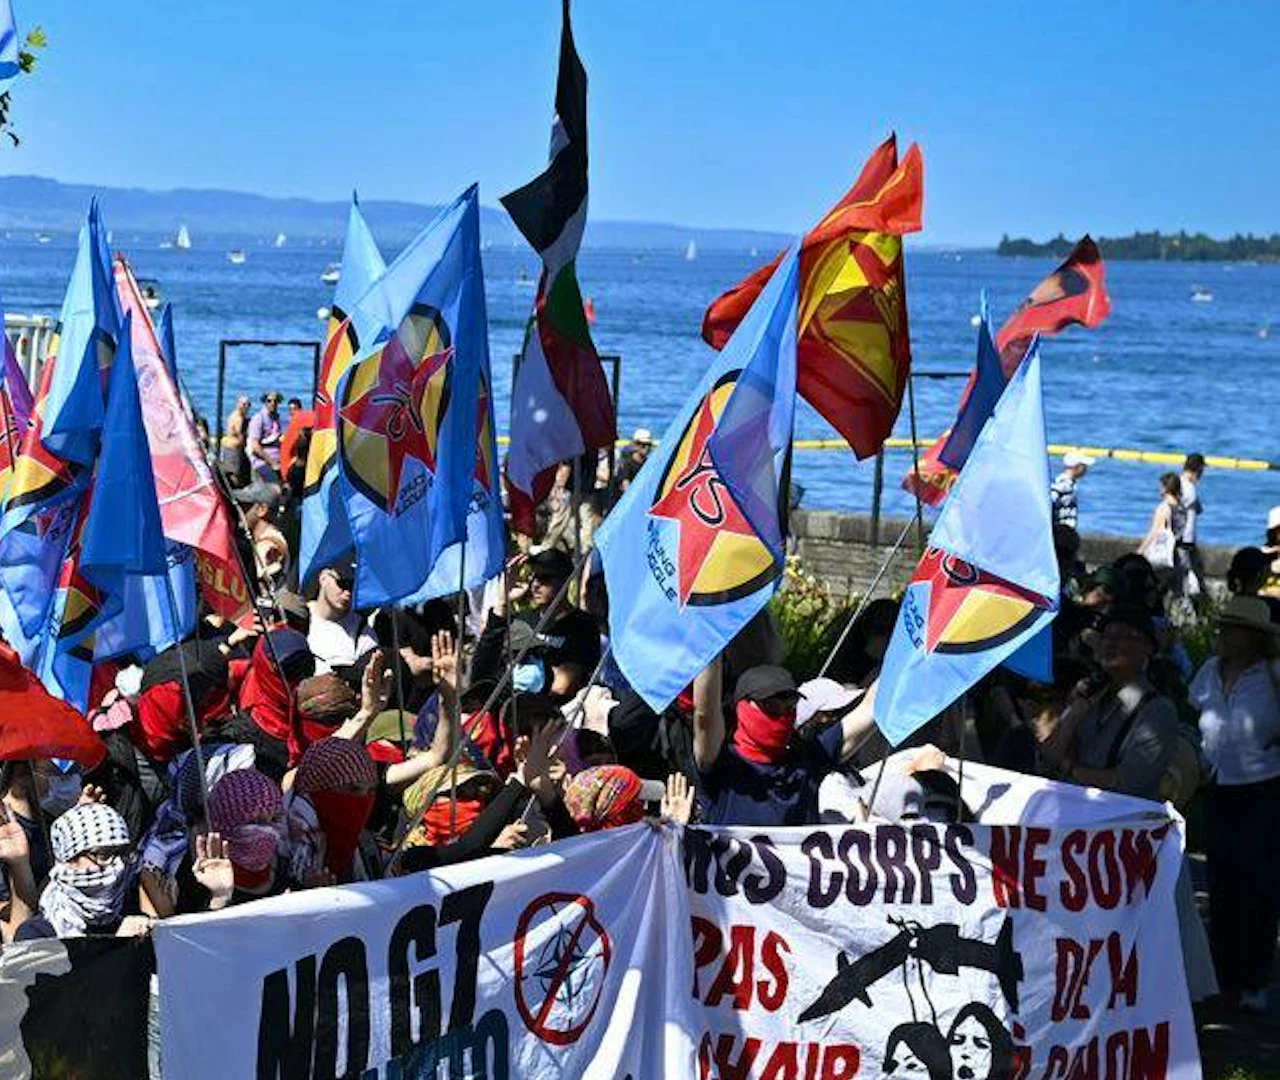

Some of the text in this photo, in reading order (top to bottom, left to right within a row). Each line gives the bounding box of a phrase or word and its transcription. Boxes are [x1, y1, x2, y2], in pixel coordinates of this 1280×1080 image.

[807, 824, 978, 908] CORPS
[989, 825, 1048, 911] NE
[388, 881, 495, 1062] G7
[689, 916, 793, 1012] PAS
